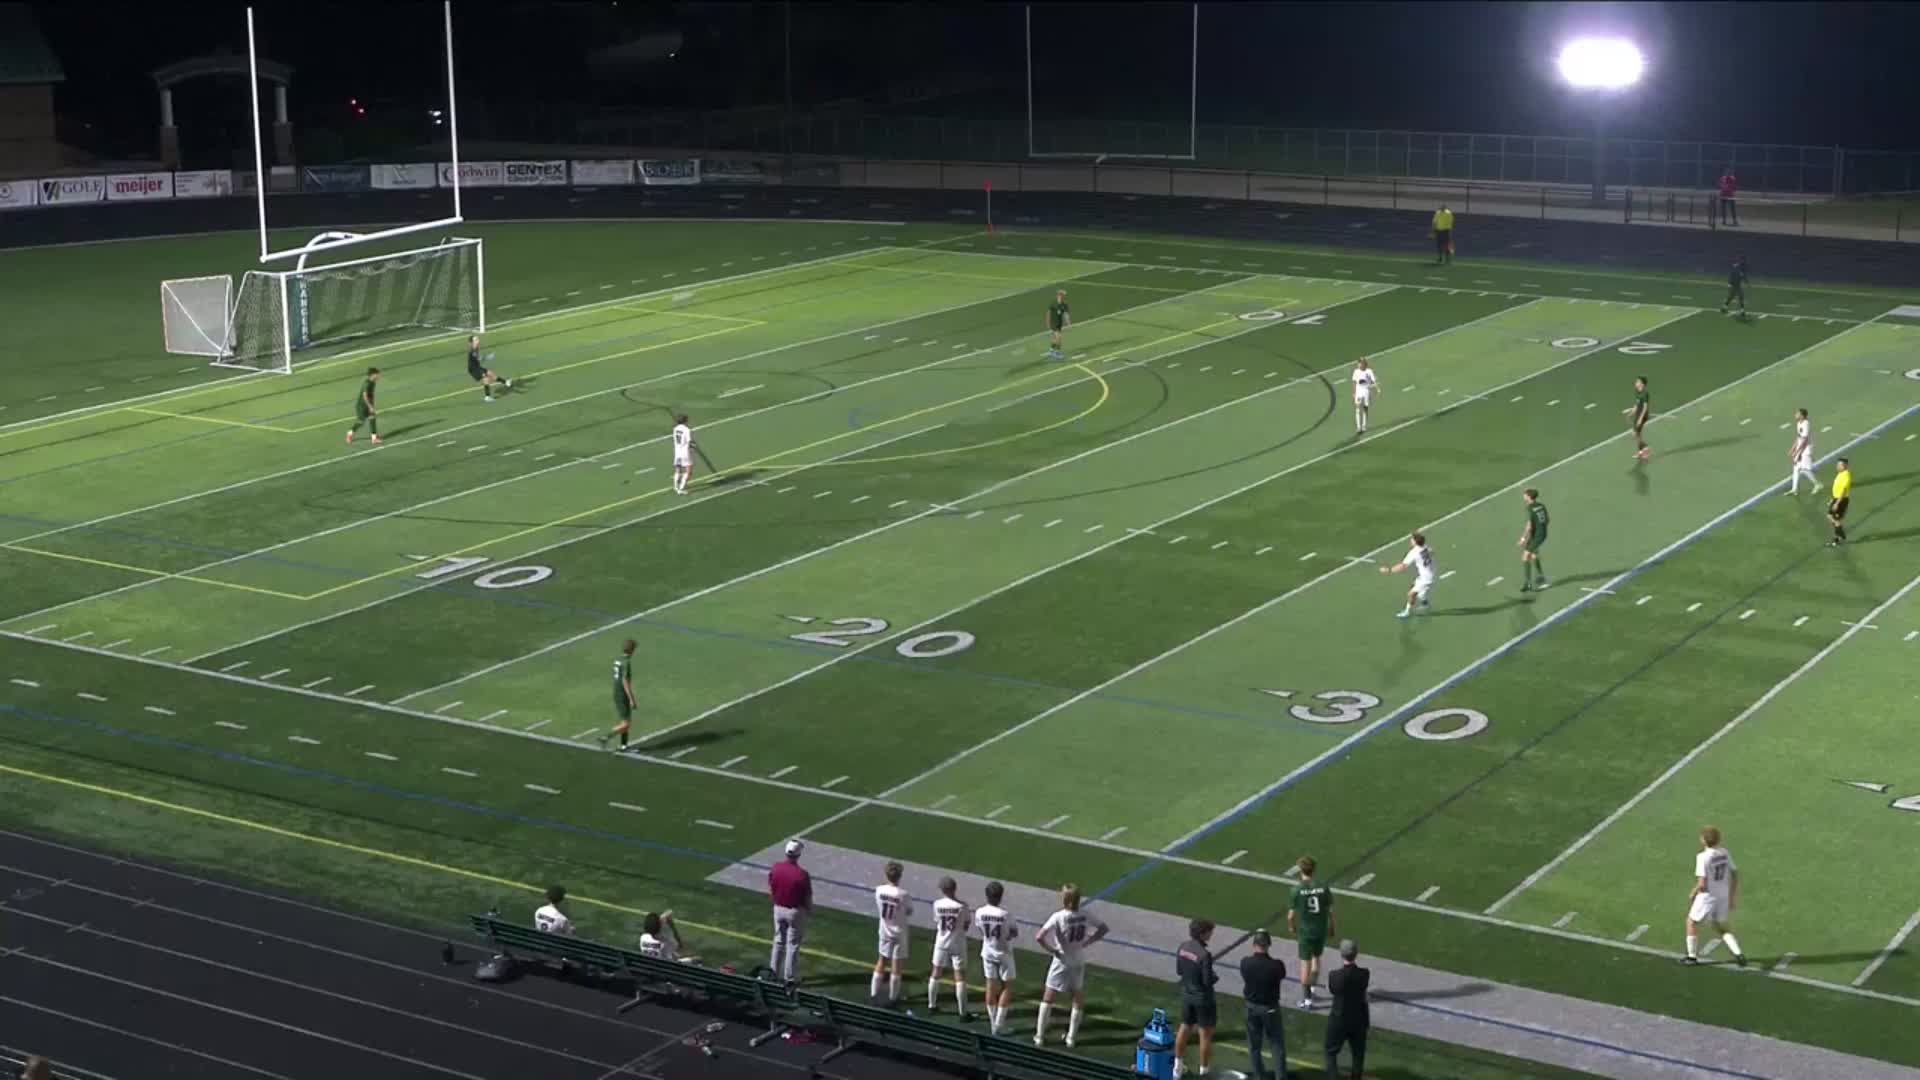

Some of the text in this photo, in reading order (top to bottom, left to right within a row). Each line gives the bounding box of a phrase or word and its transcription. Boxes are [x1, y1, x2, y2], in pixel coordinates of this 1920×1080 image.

[507, 164, 562, 175] GENTEX
[116, 177, 163, 194] meijer
[882, 902, 895, 920] 11
[1307, 896, 1320, 913] 9
[940, 916, 957, 932] 13
[983, 924, 1002, 940] 14
